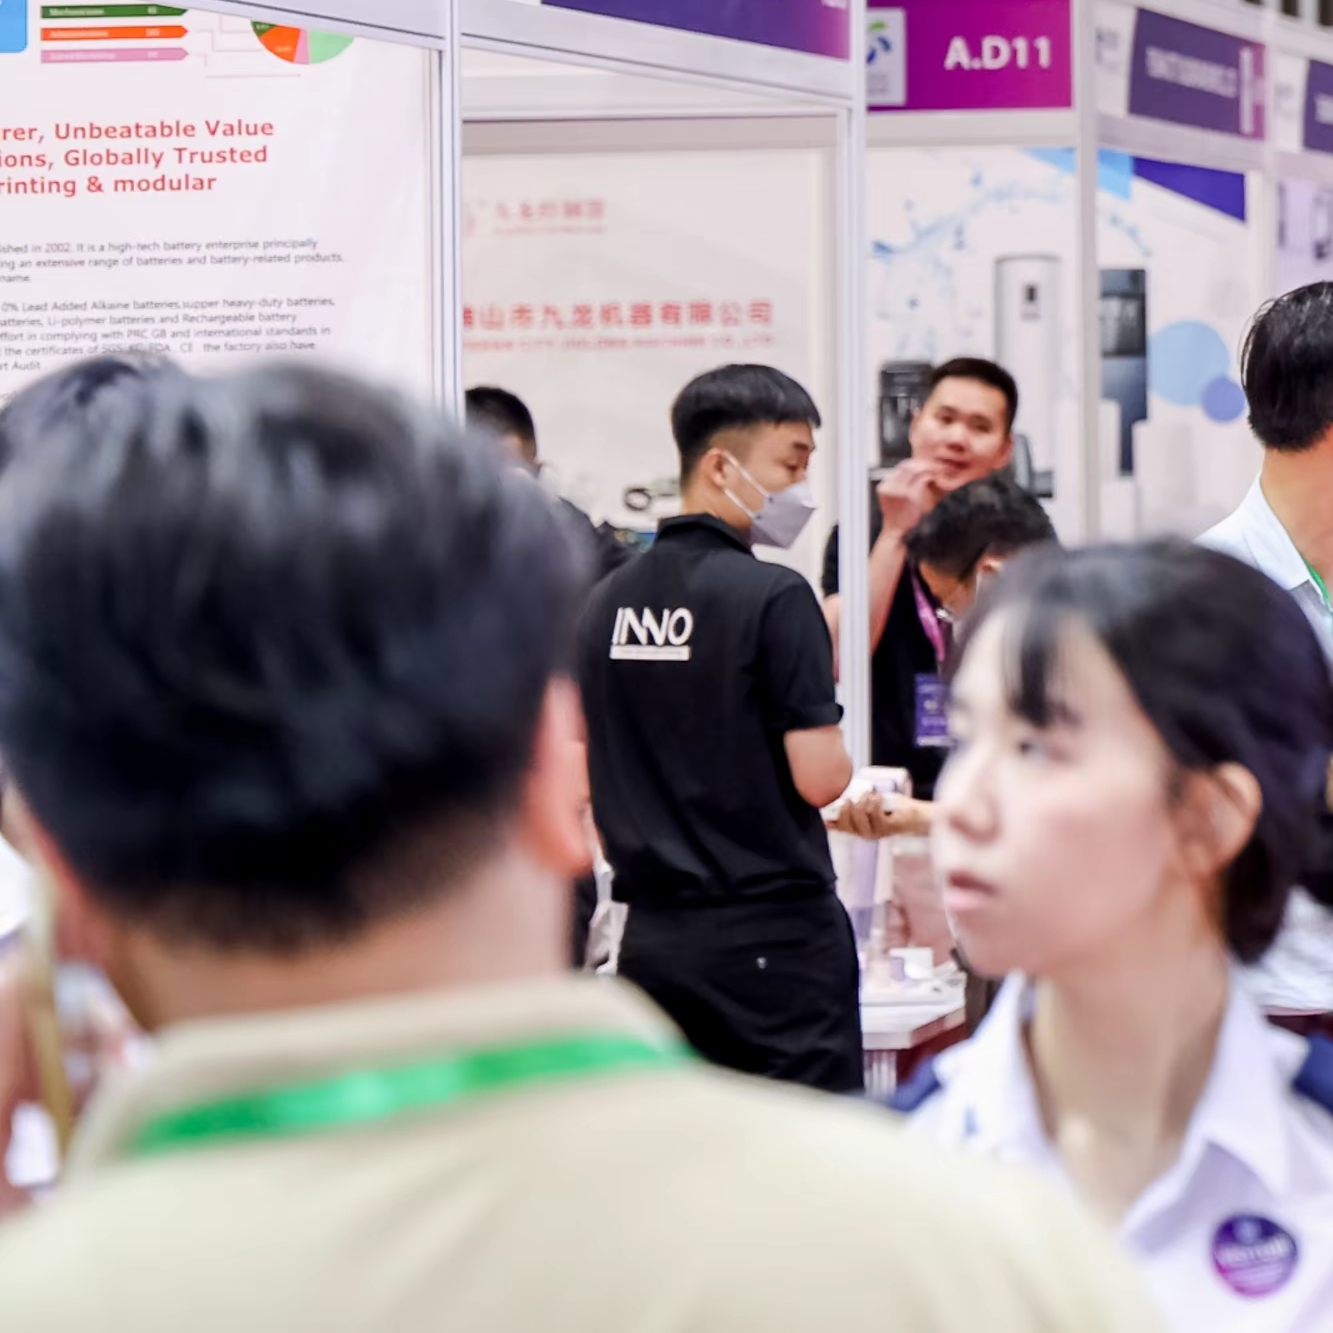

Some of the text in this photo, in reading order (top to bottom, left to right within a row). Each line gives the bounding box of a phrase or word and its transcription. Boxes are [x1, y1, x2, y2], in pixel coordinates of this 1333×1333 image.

[944, 35, 1052, 71] A.D11
[2, 119, 274, 144] rer, Unbeatable Value
[64, 147, 165, 169] Globally
[173, 145, 268, 165] Trusted
[86, 175, 104, 193] &
[114, 174, 217, 192] modular
[163, 240, 202, 252] battery
[613, 607, 693, 645] INNO
